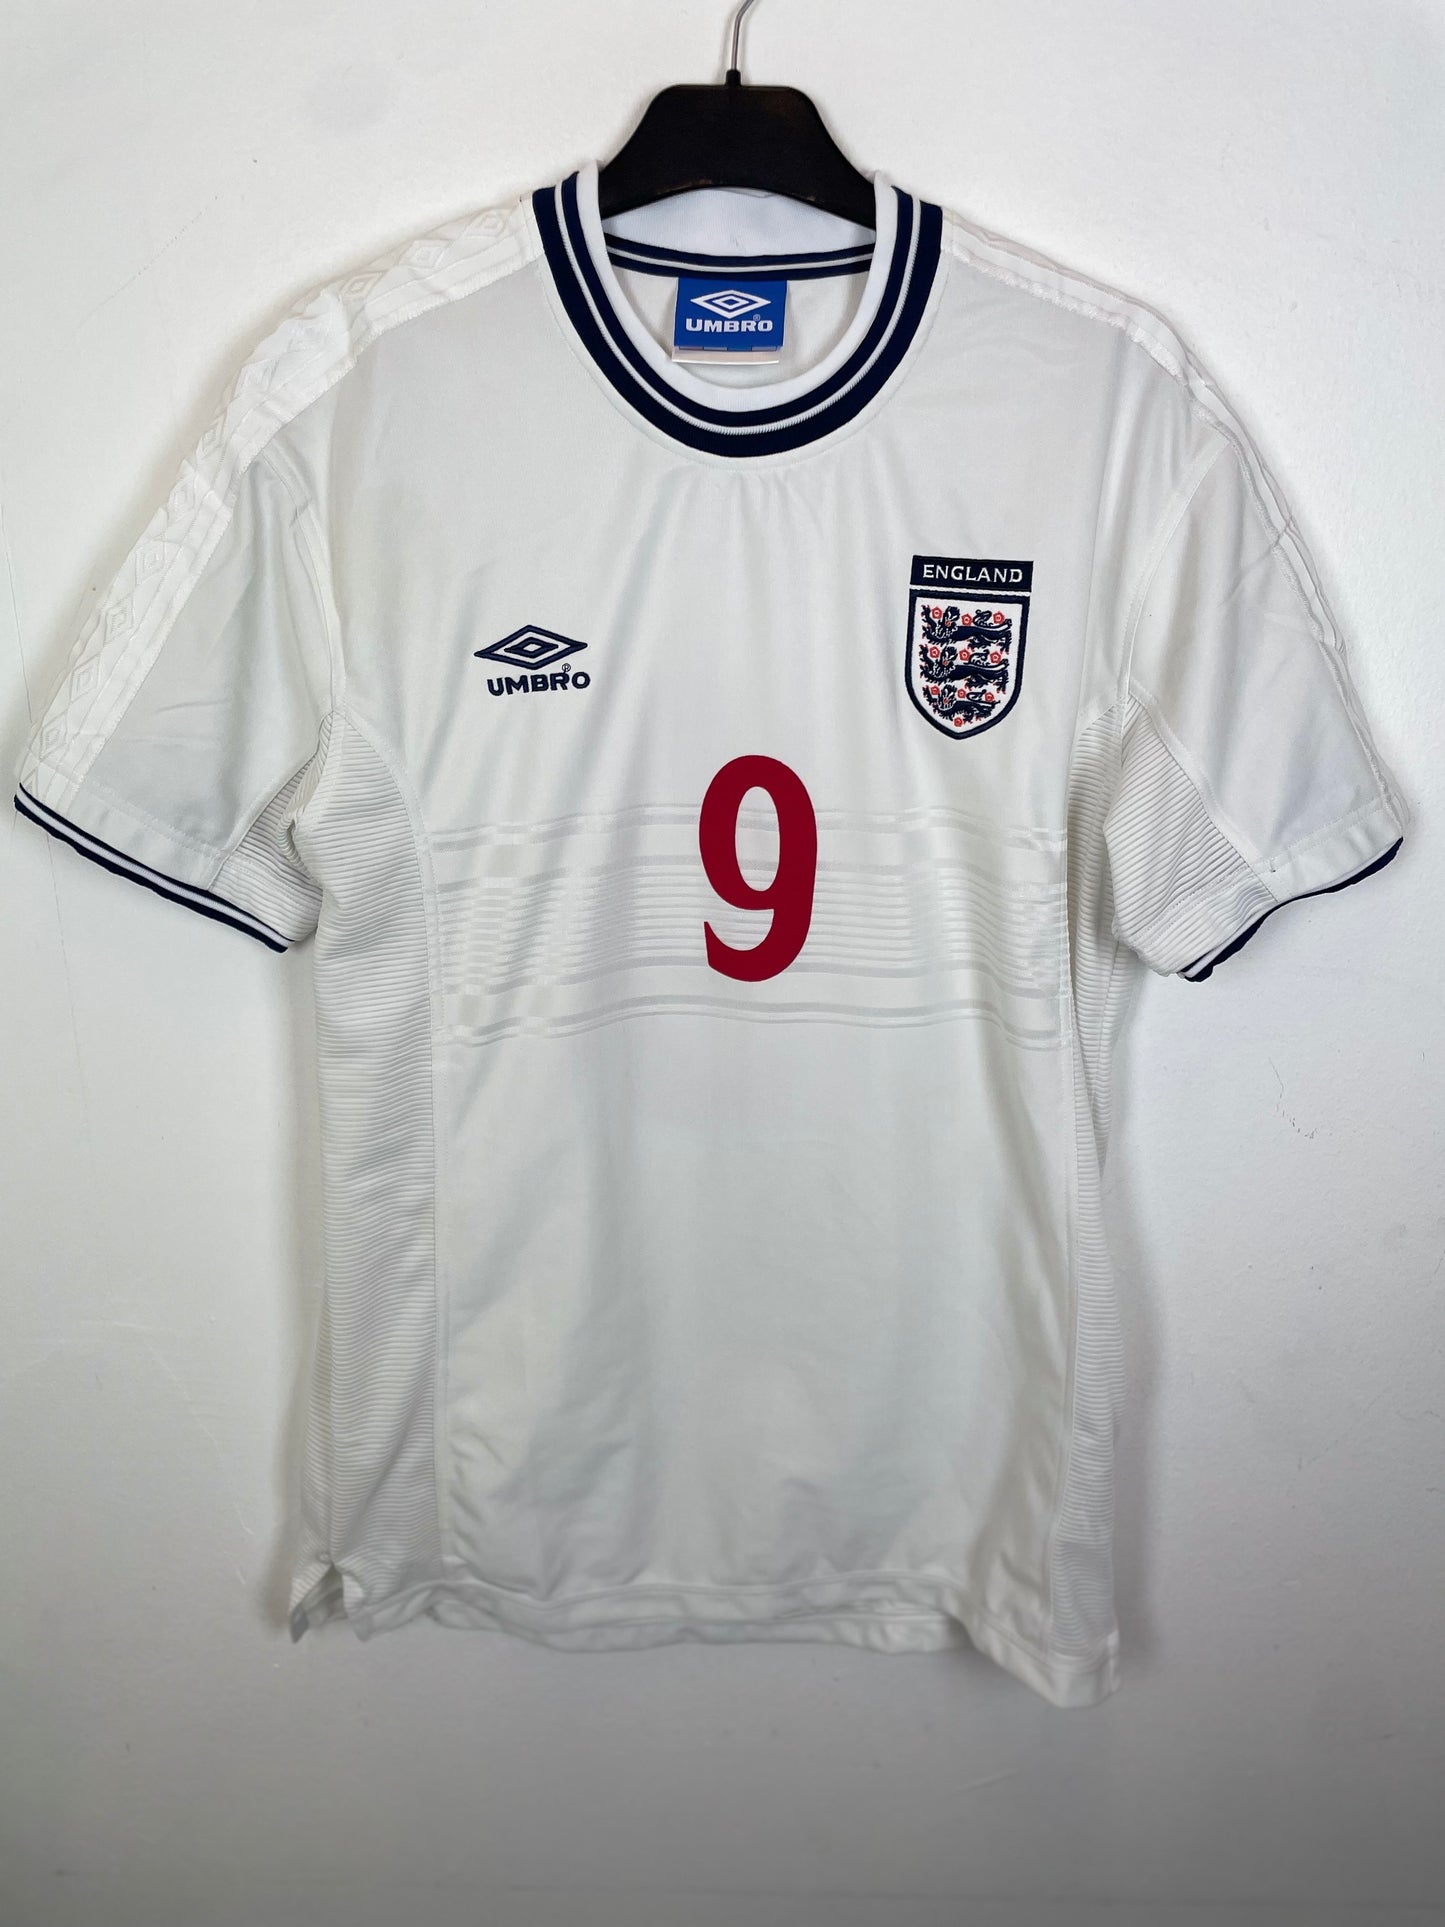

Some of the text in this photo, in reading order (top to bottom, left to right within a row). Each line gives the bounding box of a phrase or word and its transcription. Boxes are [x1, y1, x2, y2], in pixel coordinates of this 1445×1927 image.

[685, 318, 773, 333] UMBRO
[922, 564, 1023, 583] ENGLAND
[487, 671, 591, 696] UMBRO
[698, 754, 818, 982] 9
